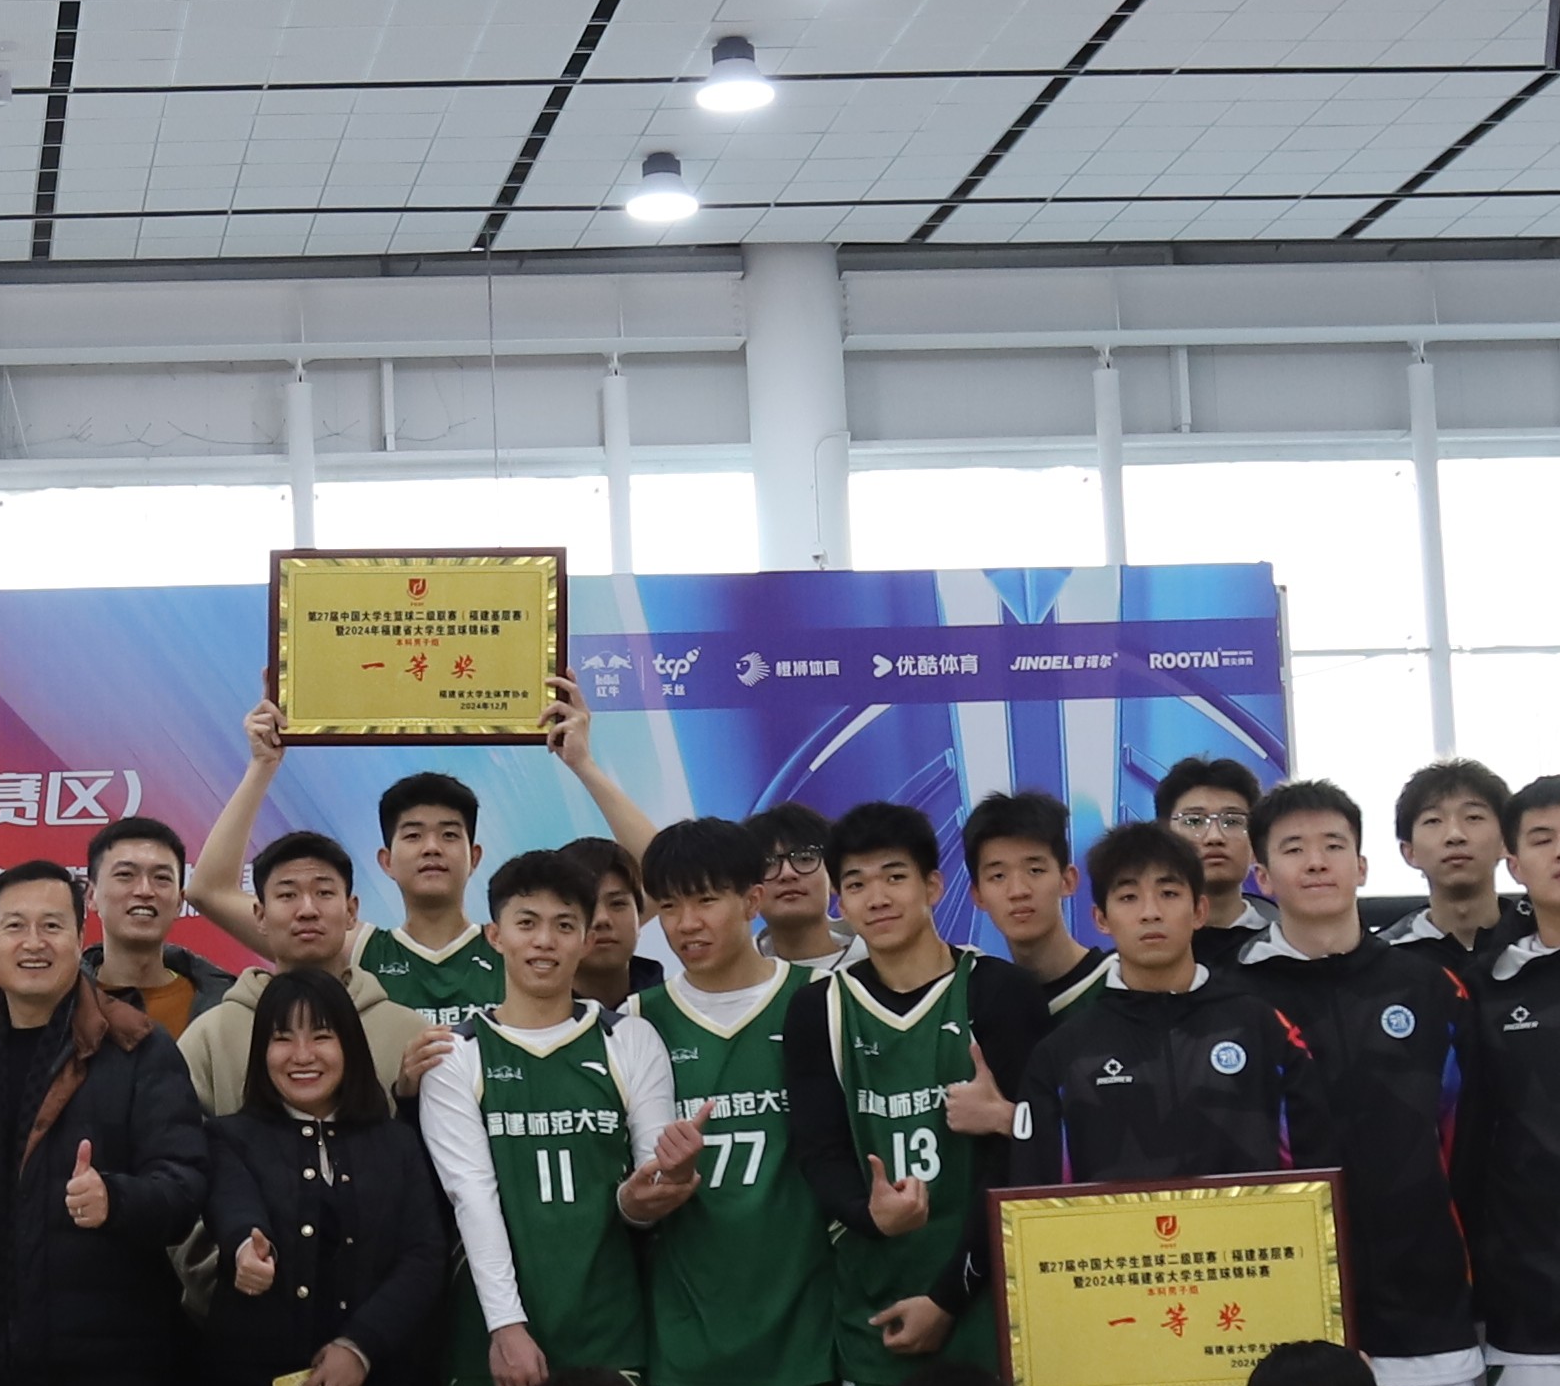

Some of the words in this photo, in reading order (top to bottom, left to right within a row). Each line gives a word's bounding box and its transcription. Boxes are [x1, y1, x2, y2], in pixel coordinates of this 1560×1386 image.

[361, 652, 476, 682] 一等奖
[652, 653, 691, 681] tcp
[776, 660, 840, 677] 橙狮体育
[896, 654, 979, 676] 优酷体育
[702, 1130, 766, 1189] 77
[892, 1127, 942, 1183] 13
[536, 1149, 575, 1203] 11
[1107, 1301, 1246, 1338] 一等奖
